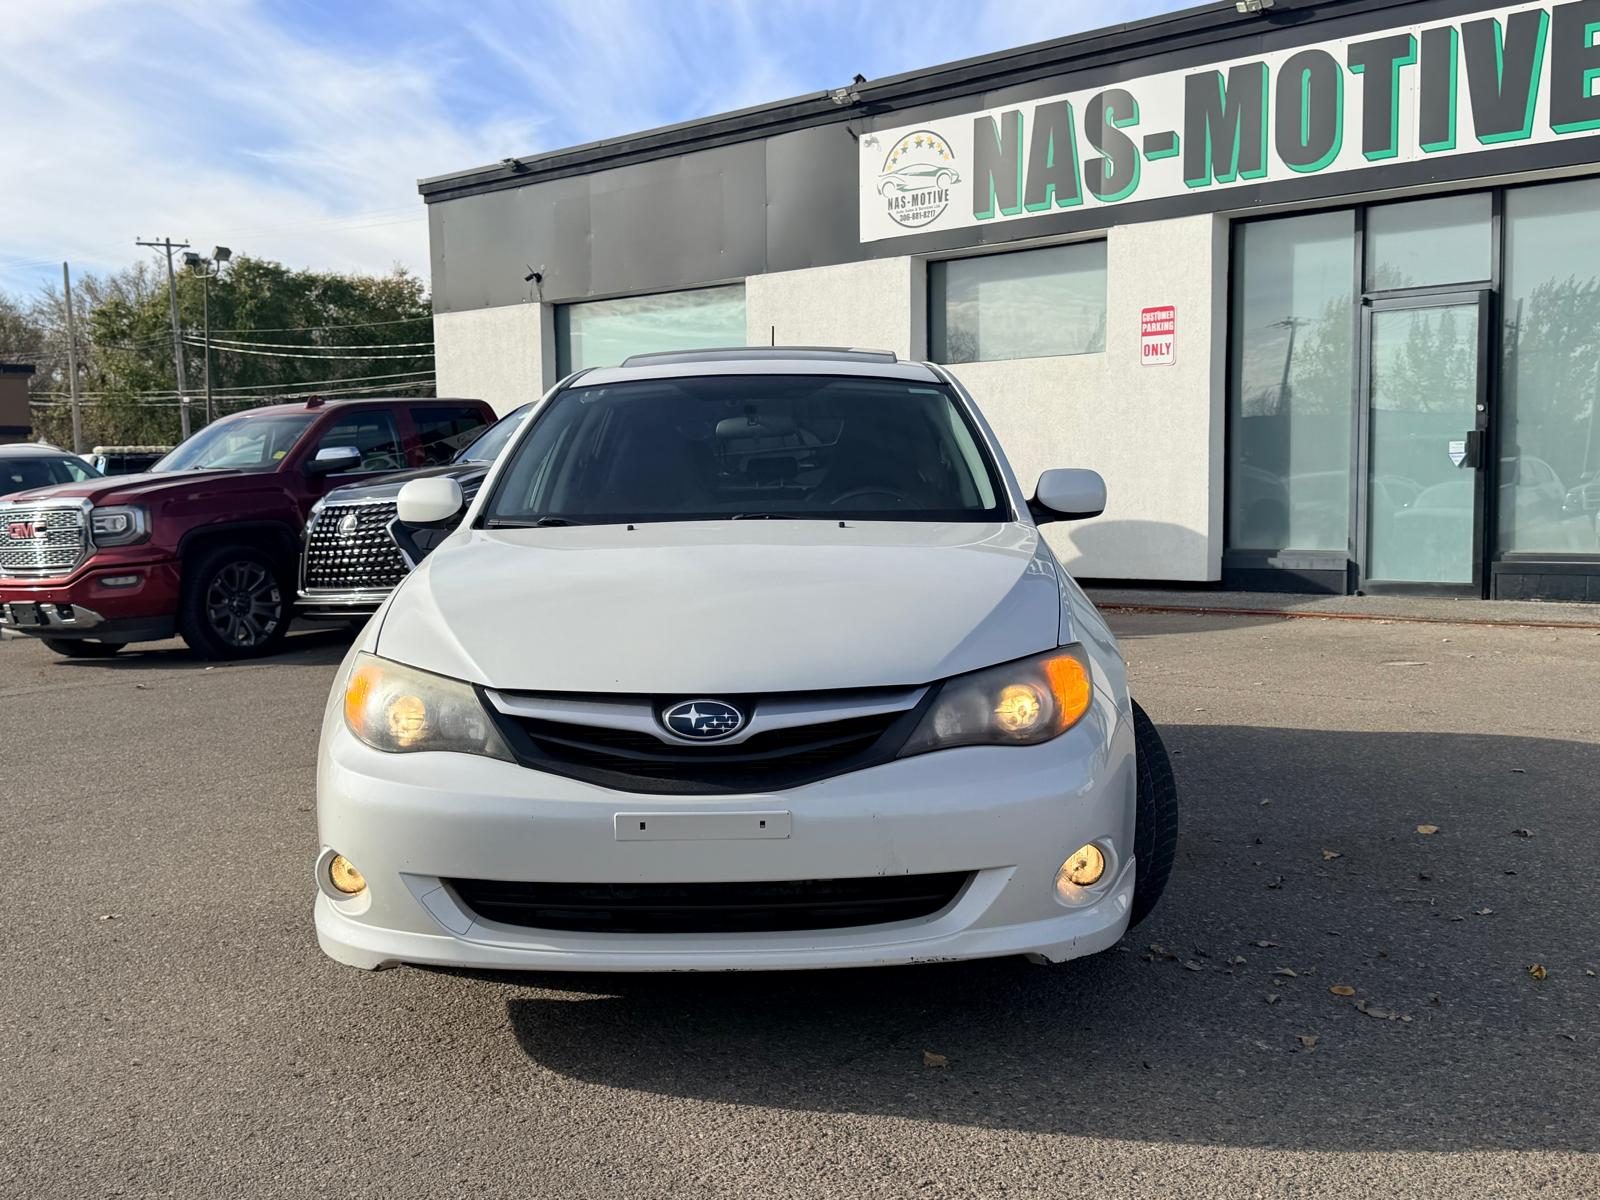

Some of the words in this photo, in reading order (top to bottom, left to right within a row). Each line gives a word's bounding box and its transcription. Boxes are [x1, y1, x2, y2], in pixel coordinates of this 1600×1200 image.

[972, 0, 1600, 221] NAS-MOTIVE
[888, 189, 949, 210] NAS-MOTIVE
[1142, 310, 1174, 322] CUSTOMER
[1142, 321, 1173, 332] PARKING
[1143, 342, 1172, 357] ONLY
[8, 521, 48, 539] GMC
